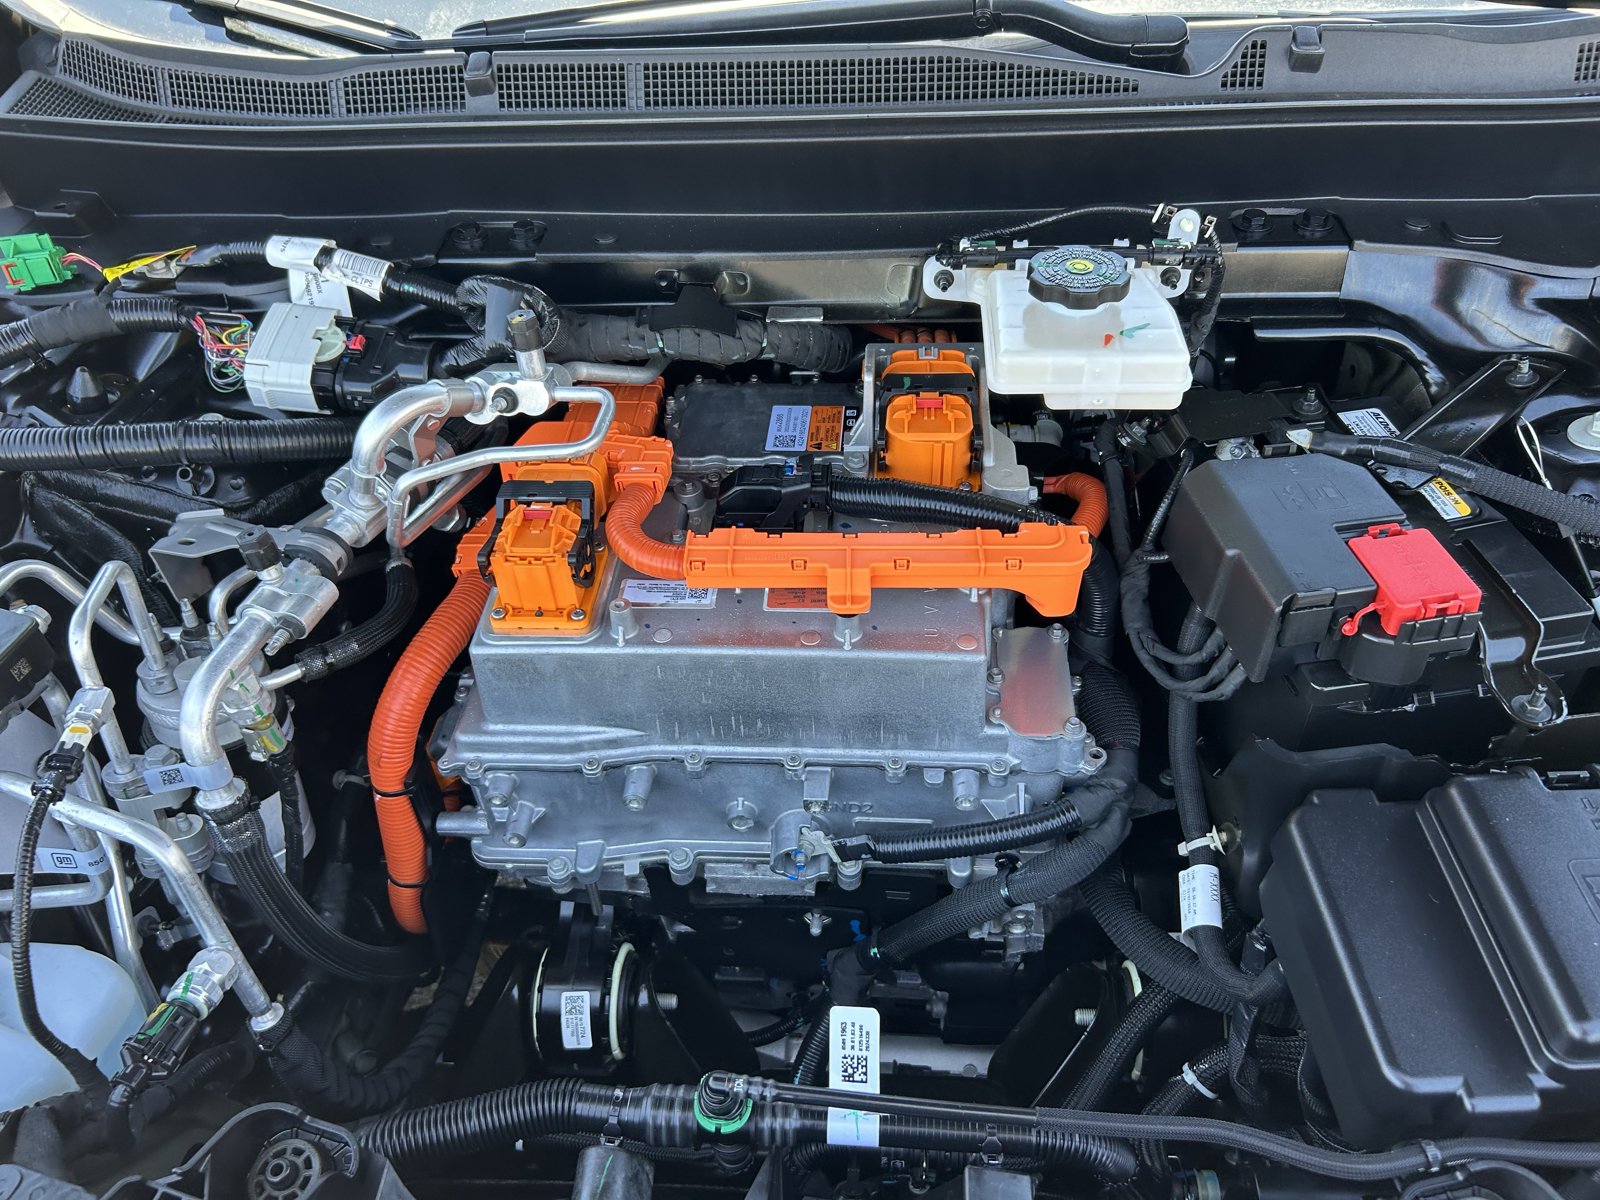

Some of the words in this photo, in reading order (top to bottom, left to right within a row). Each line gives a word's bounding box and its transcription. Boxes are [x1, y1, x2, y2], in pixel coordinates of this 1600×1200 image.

[351, 276, 374, 288] CLIPS
[1370, 410, 1399, 438] ACDelc
[1435, 480, 1461, 505] POISON
[840, 1021, 848, 1037] 1963
